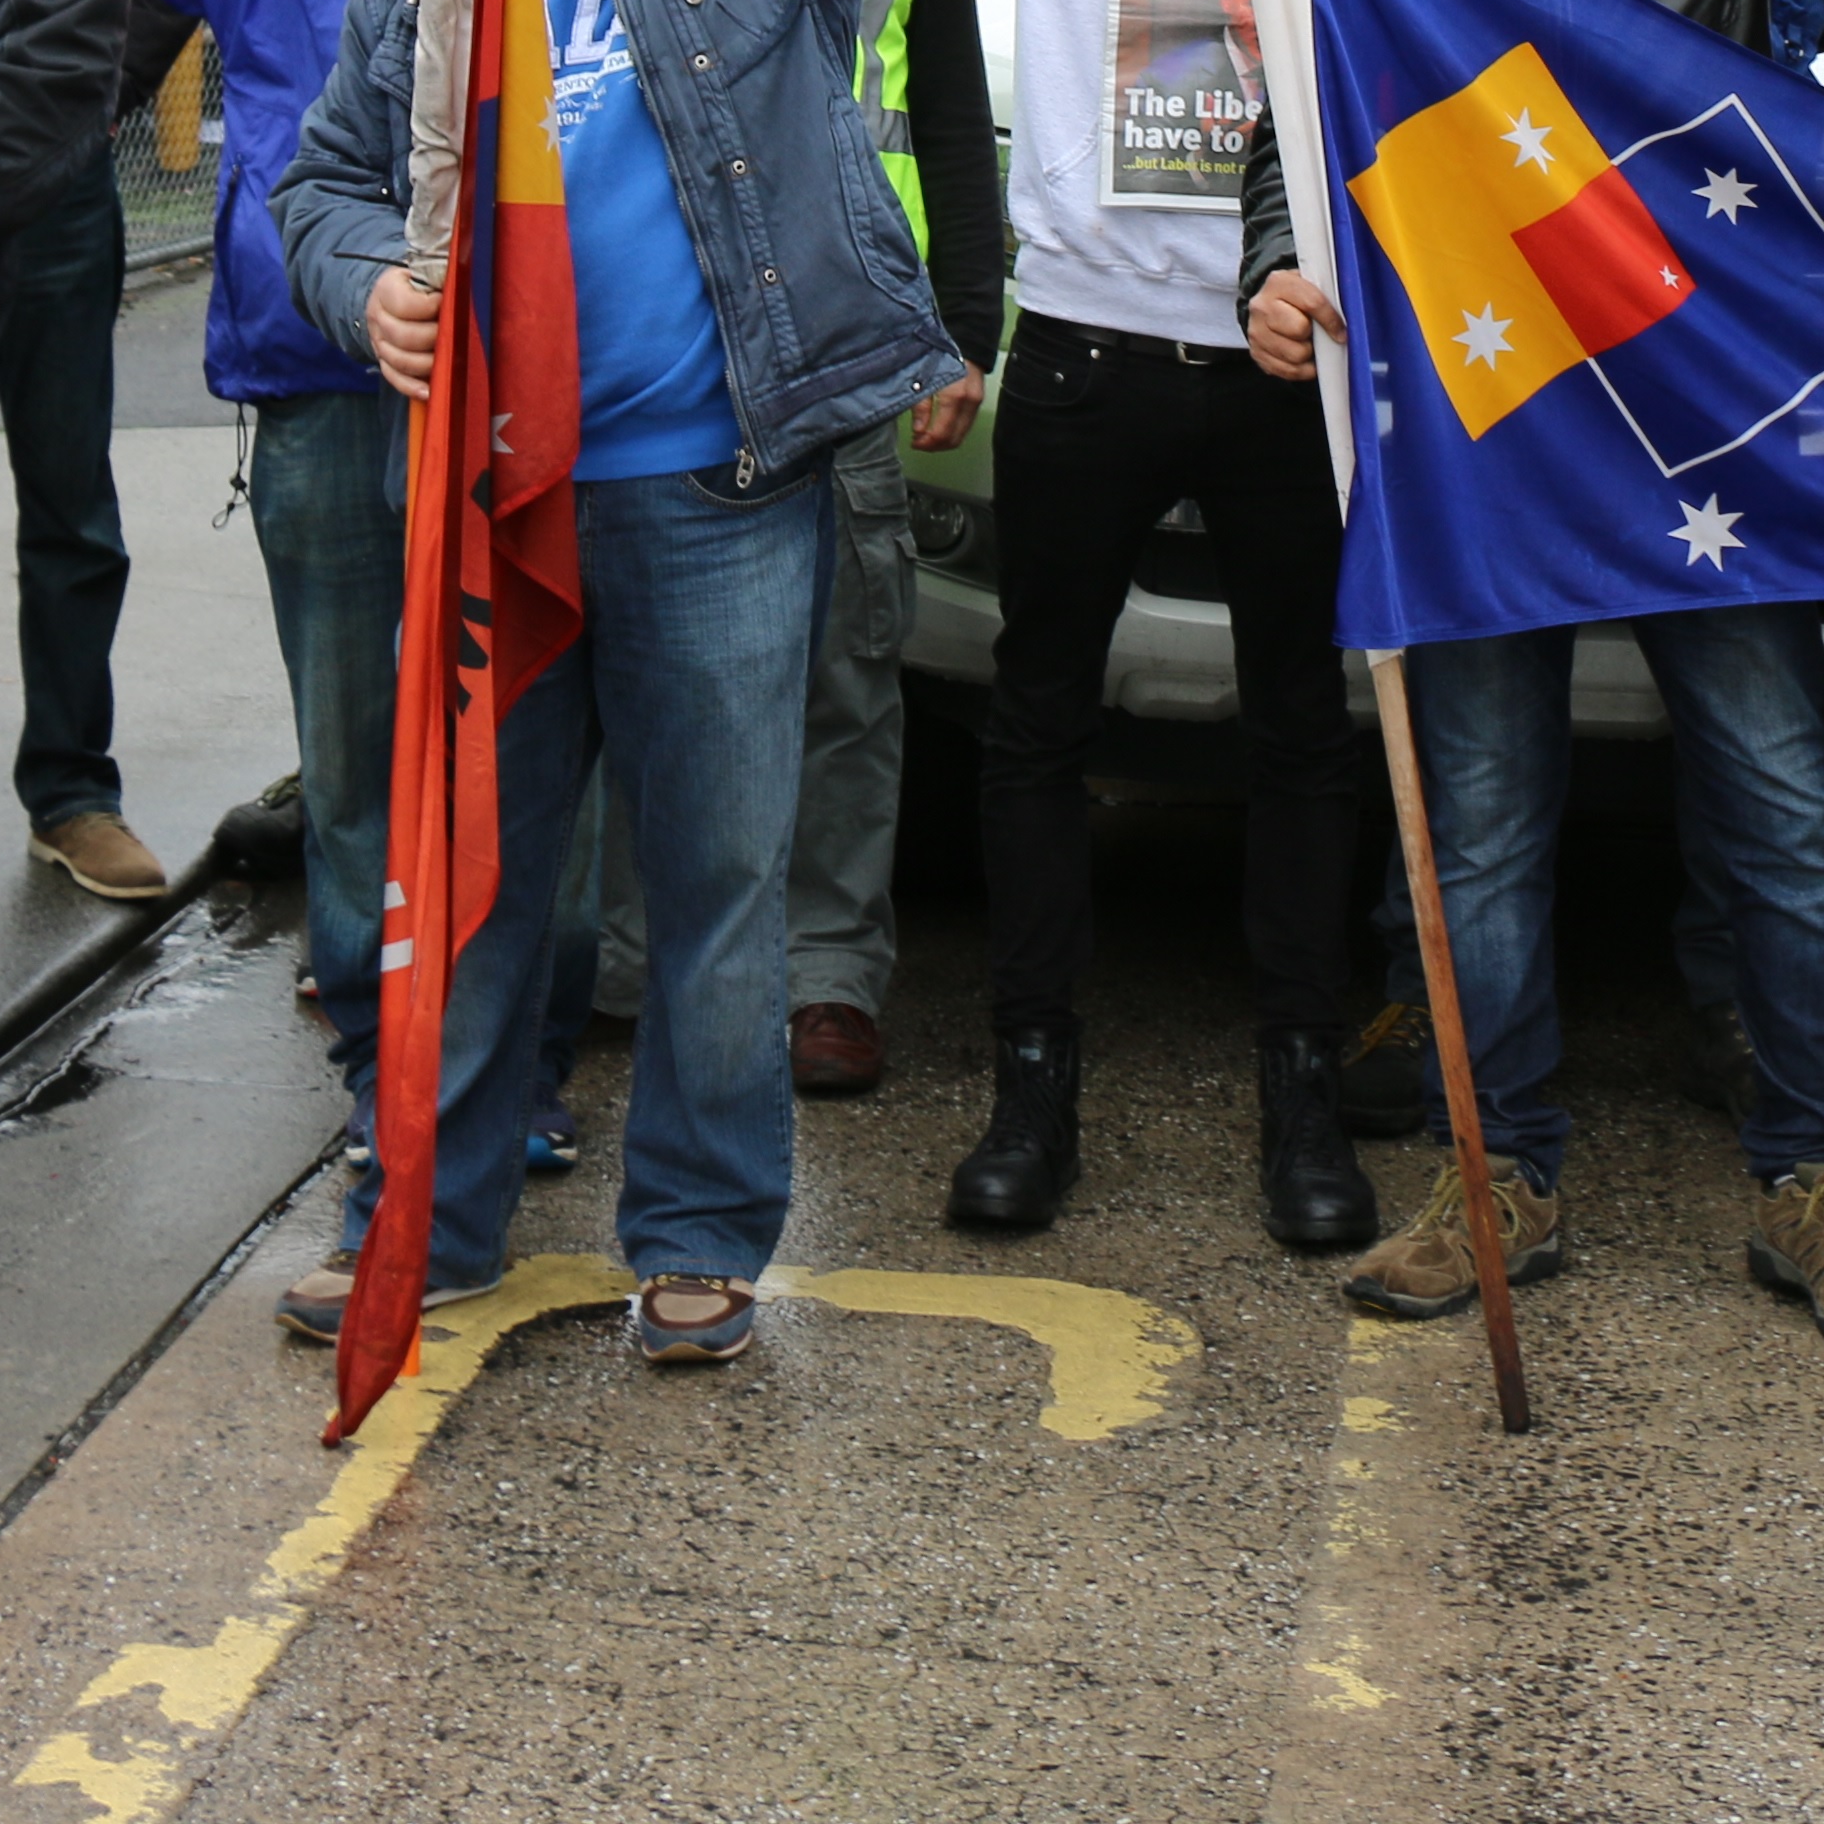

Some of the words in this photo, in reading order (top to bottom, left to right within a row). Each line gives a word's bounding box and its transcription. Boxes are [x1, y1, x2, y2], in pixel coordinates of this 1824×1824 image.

[1124, 87, 1186, 119] The
[1194, 89, 1263, 122] Libe
[1124, 120, 1202, 151] have
[1210, 126, 1245, 154] to
[1161, 157, 1198, 172] Labor
[1200, 159, 1212, 173] is
[1214, 162, 1237, 175] not
